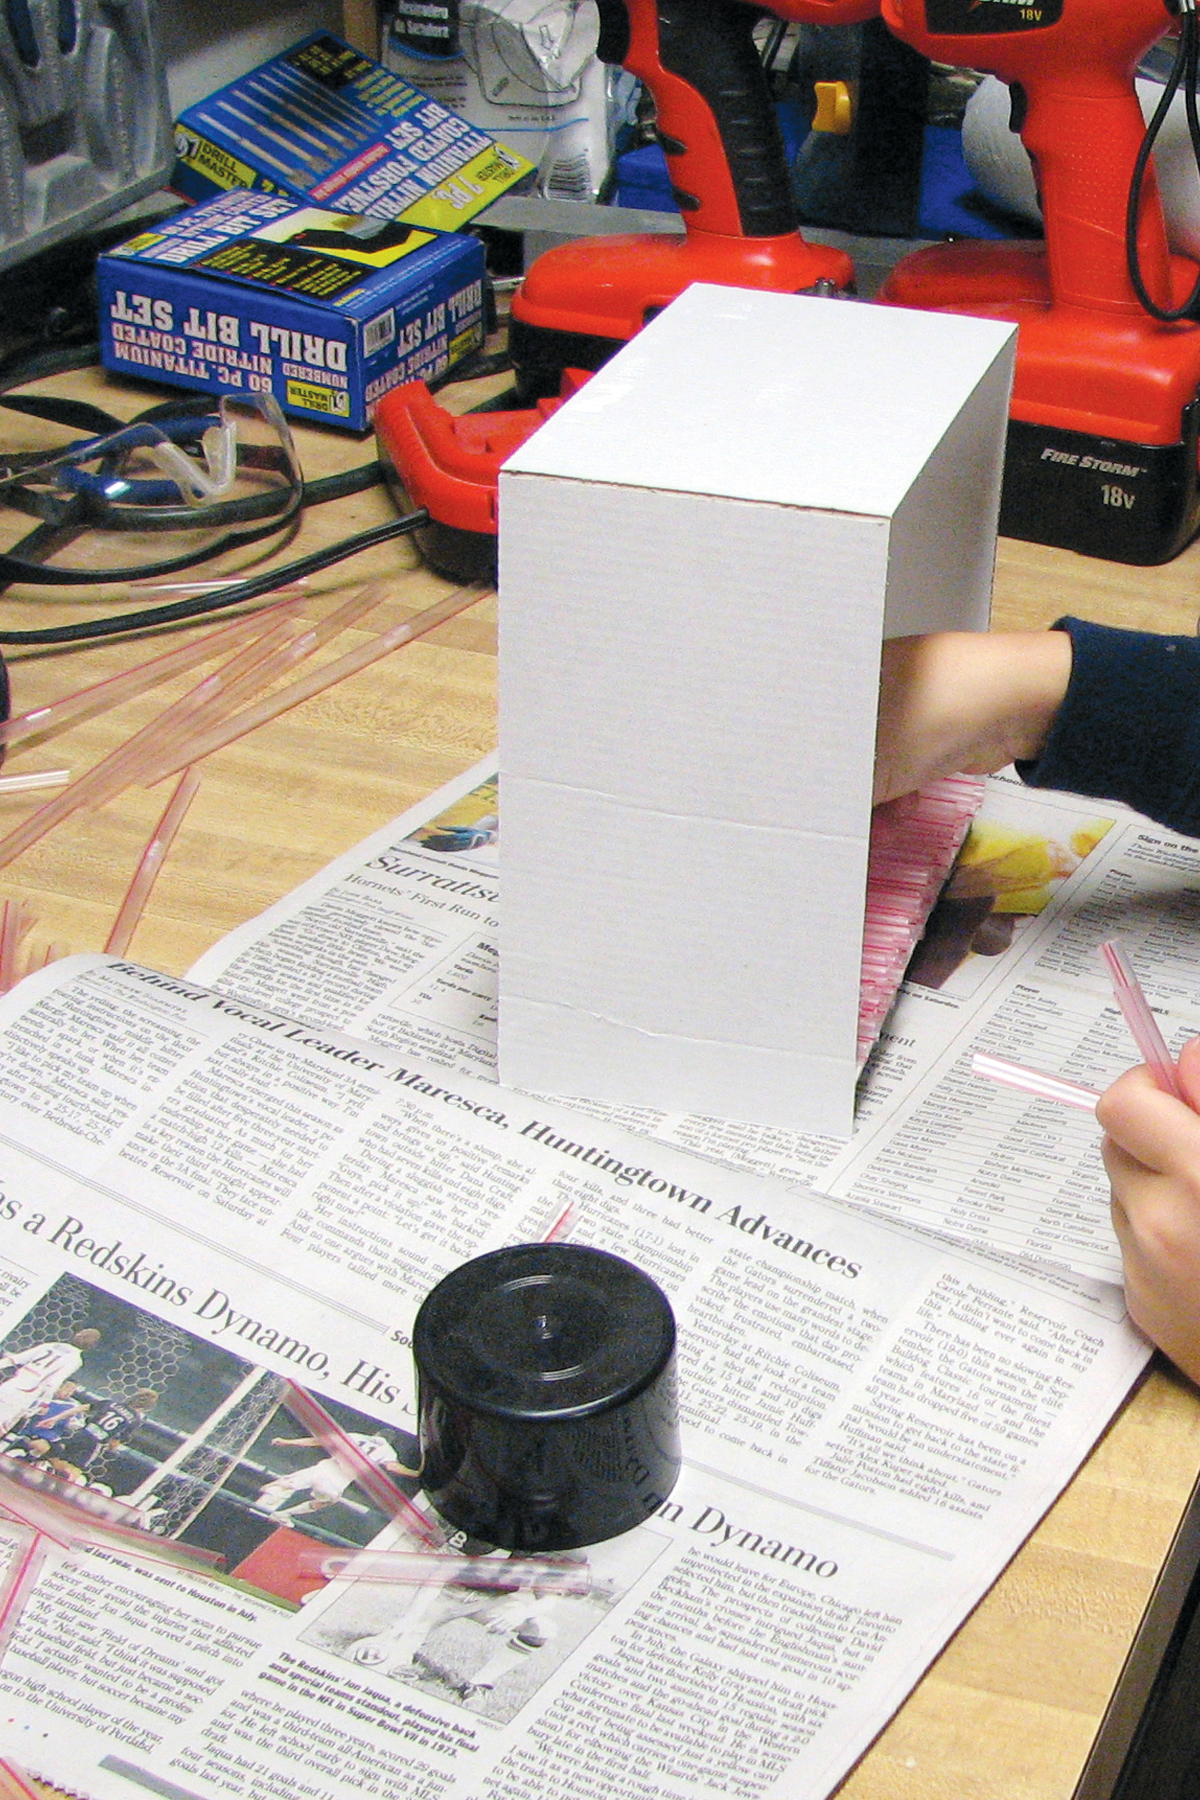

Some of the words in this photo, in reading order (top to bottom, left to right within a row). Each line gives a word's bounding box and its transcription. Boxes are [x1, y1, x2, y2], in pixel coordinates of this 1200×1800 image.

[1020, 9, 1042, 21] 18V
[385, 122, 423, 150] SET
[419, 103, 449, 129] BIT
[201, 144, 237, 173] DRILL
[407, 117, 469, 163] COATED
[414, 127, 494, 187] TITANIUM
[200, 154, 248, 190] MASTER
[155, 234, 229, 264] DRILL
[218, 213, 262, 236] BIT
[249, 198, 299, 218] SET
[110, 290, 174, 331] SET
[183, 307, 239, 347] BIT
[111, 321, 187, 355] COATED
[191, 340, 273, 375] NITRIDE
[250, 321, 348, 372] DRILL
[397, 318, 422, 358] SET
[114, 340, 210, 379] TITANIUM
[211, 363, 243, 387] PC.
[282, 362, 348, 389] NUMBERED
[248, 373, 273, 393] 60
[289, 385, 329, 402] MASTER
[302, 397, 329, 412] DRILL
[1041, 448, 1078, 466] FIRE
[1079, 456, 1140, 477] STORM
[1138, 835, 1161, 844] Sign
[410, 890, 447, 911] First
[449, 903, 482, 921] Run
[485, 915, 499, 928] to
[104, 957, 204, 1005] Behind
[211, 999, 287, 1031] Vocal
[280, 1025, 389, 1075] Leader
[388, 1064, 510, 1130] Maresca,
[519, 1120, 712, 1213] Huntingtown
[717, 1205, 864, 1280] Advances
[729, 1248, 752, 1261] state
[756, 1260, 821, 1294] championship
[863, 1308, 888, 1323] when
[23, 1211, 41, 1235] a
[48, 1215, 194, 1307] Redskins
[193, 1288, 331, 1381] Dynamo,
[341, 1359, 402, 1405] His
[702, 1286, 730, 1302] scribe
[734, 1299, 748, 1310] the
[752, 1309, 796, 1332] emotions
[800, 1329, 819, 1344] that
[822, 1340, 839, 1352] day
[936, 1282, 967, 1298] Carole
[972, 1296, 1013, 1318] Ferrante
[1081, 1342, 1098, 1355] last
[693, 1318, 739, 1346] Yesterday
[742, 1344, 752, 1352] at
[755, 1348, 790, 1368] Ritchie
[924, 1321, 952, 1338] There
[954, 1334, 970, 1347] has
[973, 1343, 996, 1359] been
[998, 1356, 1011, 1365] no
[1014, 1363, 1052, 1382] slowing
[100, 1410, 122, 1431] 16
[687, 1504, 839, 1579] Dynamo
[96, 1552, 111, 1560] last
[135, 1568, 152, 1578] was
[154, 1576, 176, 1587] sent
[176, 1584, 186, 1592] to
[188, 1589, 226, 1608] Houston
[688, 1547, 700, 1556] he
[704, 1554, 734, 1568] would
[734, 1563, 760, 1577] leave
[762, 1574, 776, 1584] for
[821, 1596, 861, 1614] Chicago
[864, 1609, 880, 1619] left
[882, 1614, 902, 1625] him
[41, 1579, 65, 1592] their
[100, 1602, 118, 1614] Jon
[120, 1612, 148, 1628] Jaqua
[151, 1620, 185, 1642] carved
[192, 1644, 220, 1658] pitch
[222, 1654, 243, 1667] into
[51, 1572, 82, 1586] soccer
[84, 1585, 104, 1595] and
[104, 1593, 133, 1607] avoid
[134, 1605, 150, 1615] the
[152, 1611, 188, 1632] injuries
[190, 1629, 211, 1640] that
[213, 1638, 255, 1658] afflicted
[258, 1672, 286, 1686] game
[287, 1683, 298, 1692] in
[299, 1688, 316, 1698] the
[318, 1695, 334, 1706] NFL
[335, 1702, 346, 1711] in
[348, 1707, 376, 1723] Super
[377, 1720, 403, 1734] Bowl
[404, 1731, 418, 1741] VII
[418, 1738, 428, 1746] in
[269, 1663, 289, 1674] and
[289, 1672, 324, 1688] special
[324, 1686, 354, 1701] teams
[402, 1720, 438, 1736] played
[438, 1732, 453, 1742] his
[455, 1738, 479, 1752] final
[280, 1651, 297, 1664] The
[344, 1680, 361, 1690] Jon
[403, 1706, 450, 1728] defensive
[452, 1724, 476, 1738] back
